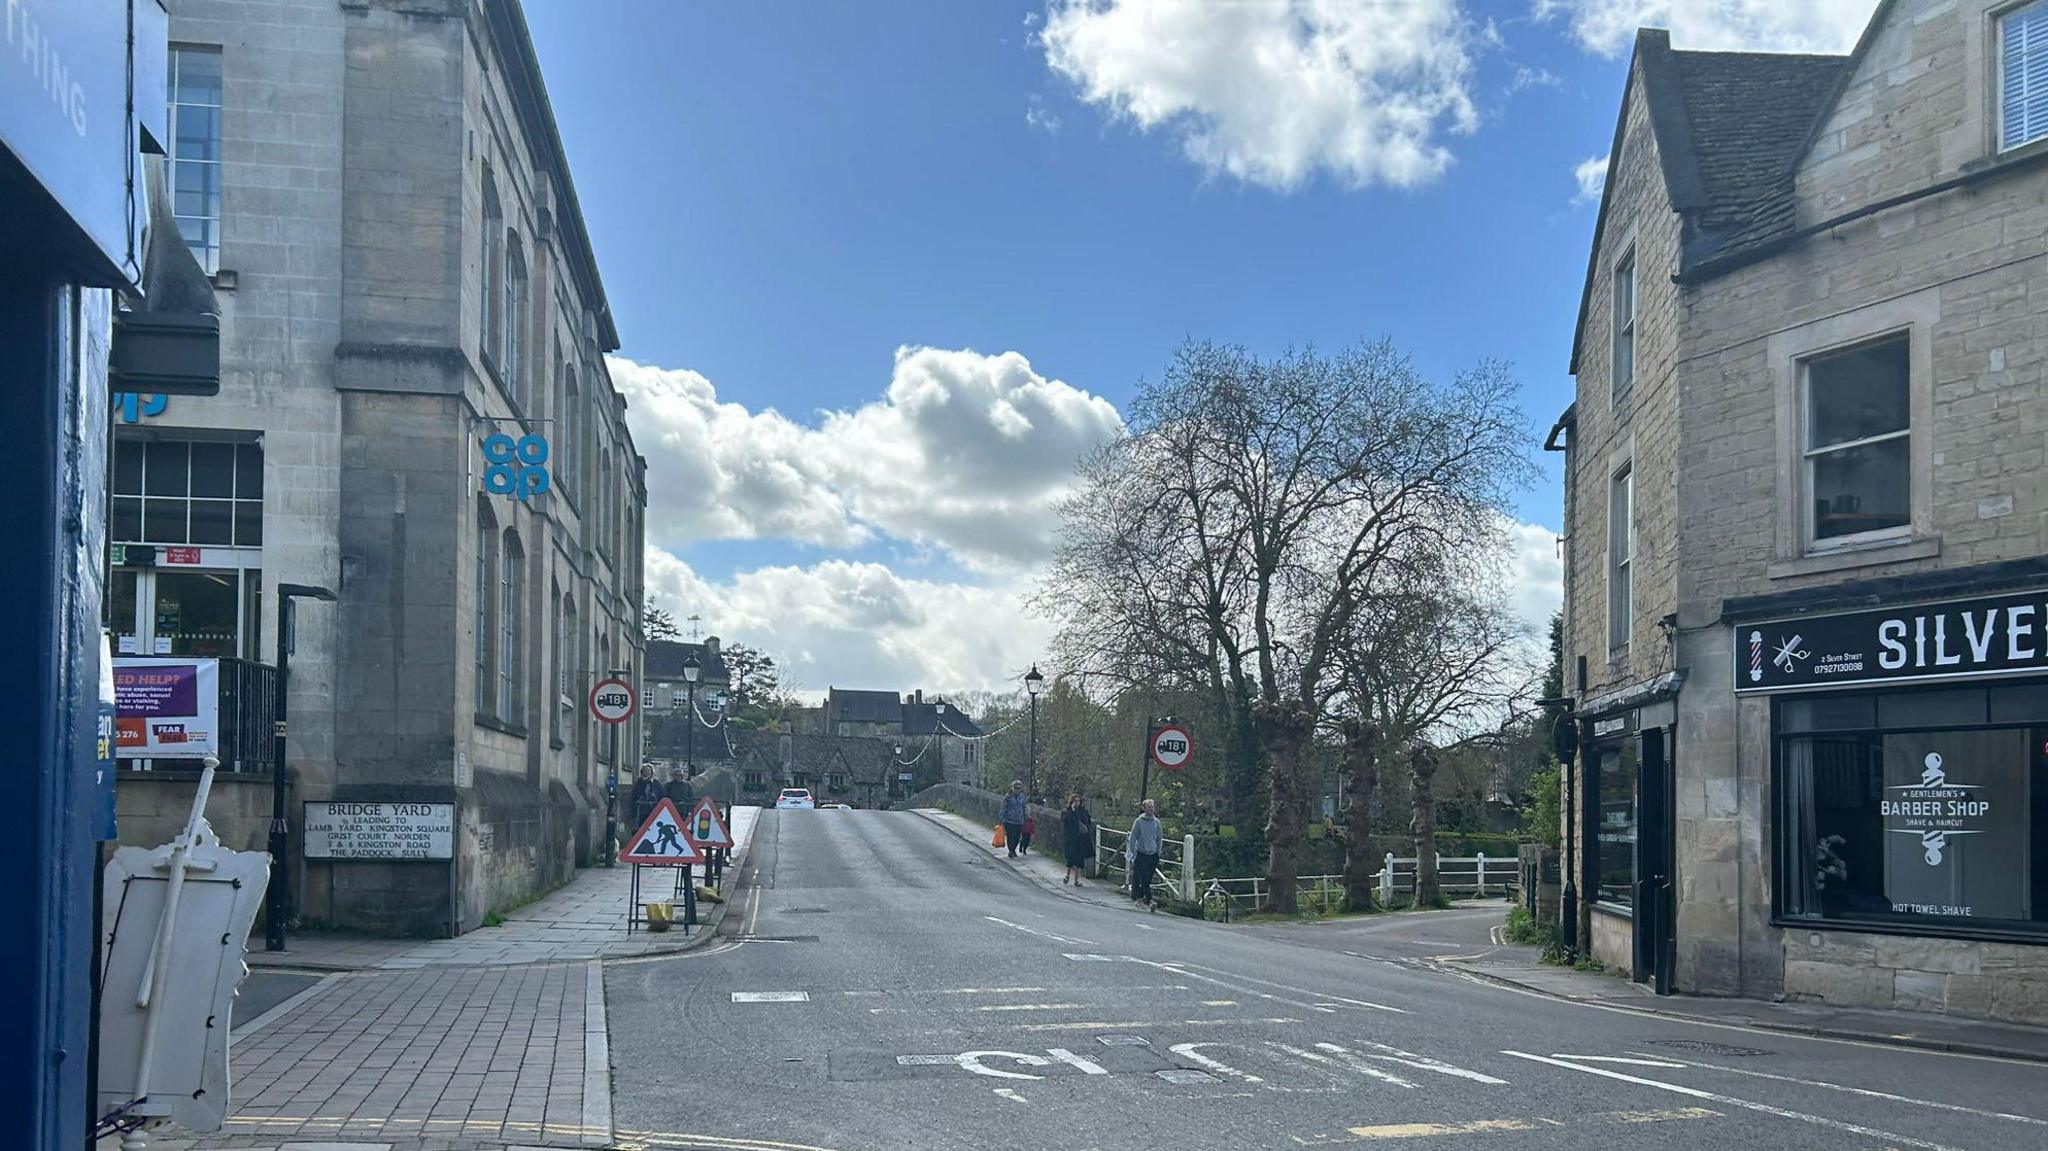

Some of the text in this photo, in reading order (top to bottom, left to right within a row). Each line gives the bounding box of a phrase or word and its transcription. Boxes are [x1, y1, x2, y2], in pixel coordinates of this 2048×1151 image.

[1878, 603, 2048, 669] SILVE
[138, 674, 180, 684] HELP?
[122, 730, 139, 739] 276
[328, 804, 382, 816] BRIDGE
[392, 805, 432, 816] YARD
[1881, 800, 1990, 816] BARBER SHOP
[1906, 818, 1926, 826] SHAVE
[1936, 818, 1963, 826] HAIRCUT
[308, 824, 333, 832] LAMB
[416, 825, 451, 833] SQUARE
[327, 832, 352, 840] GRIST
[358, 840, 402, 848] KINGSTON
[406, 841, 431, 849] ROAD
[330, 849, 346, 857] THE
[402, 849, 428, 857] SULLY
[1892, 902, 1972, 916] HOT TOWEL SHAVE
